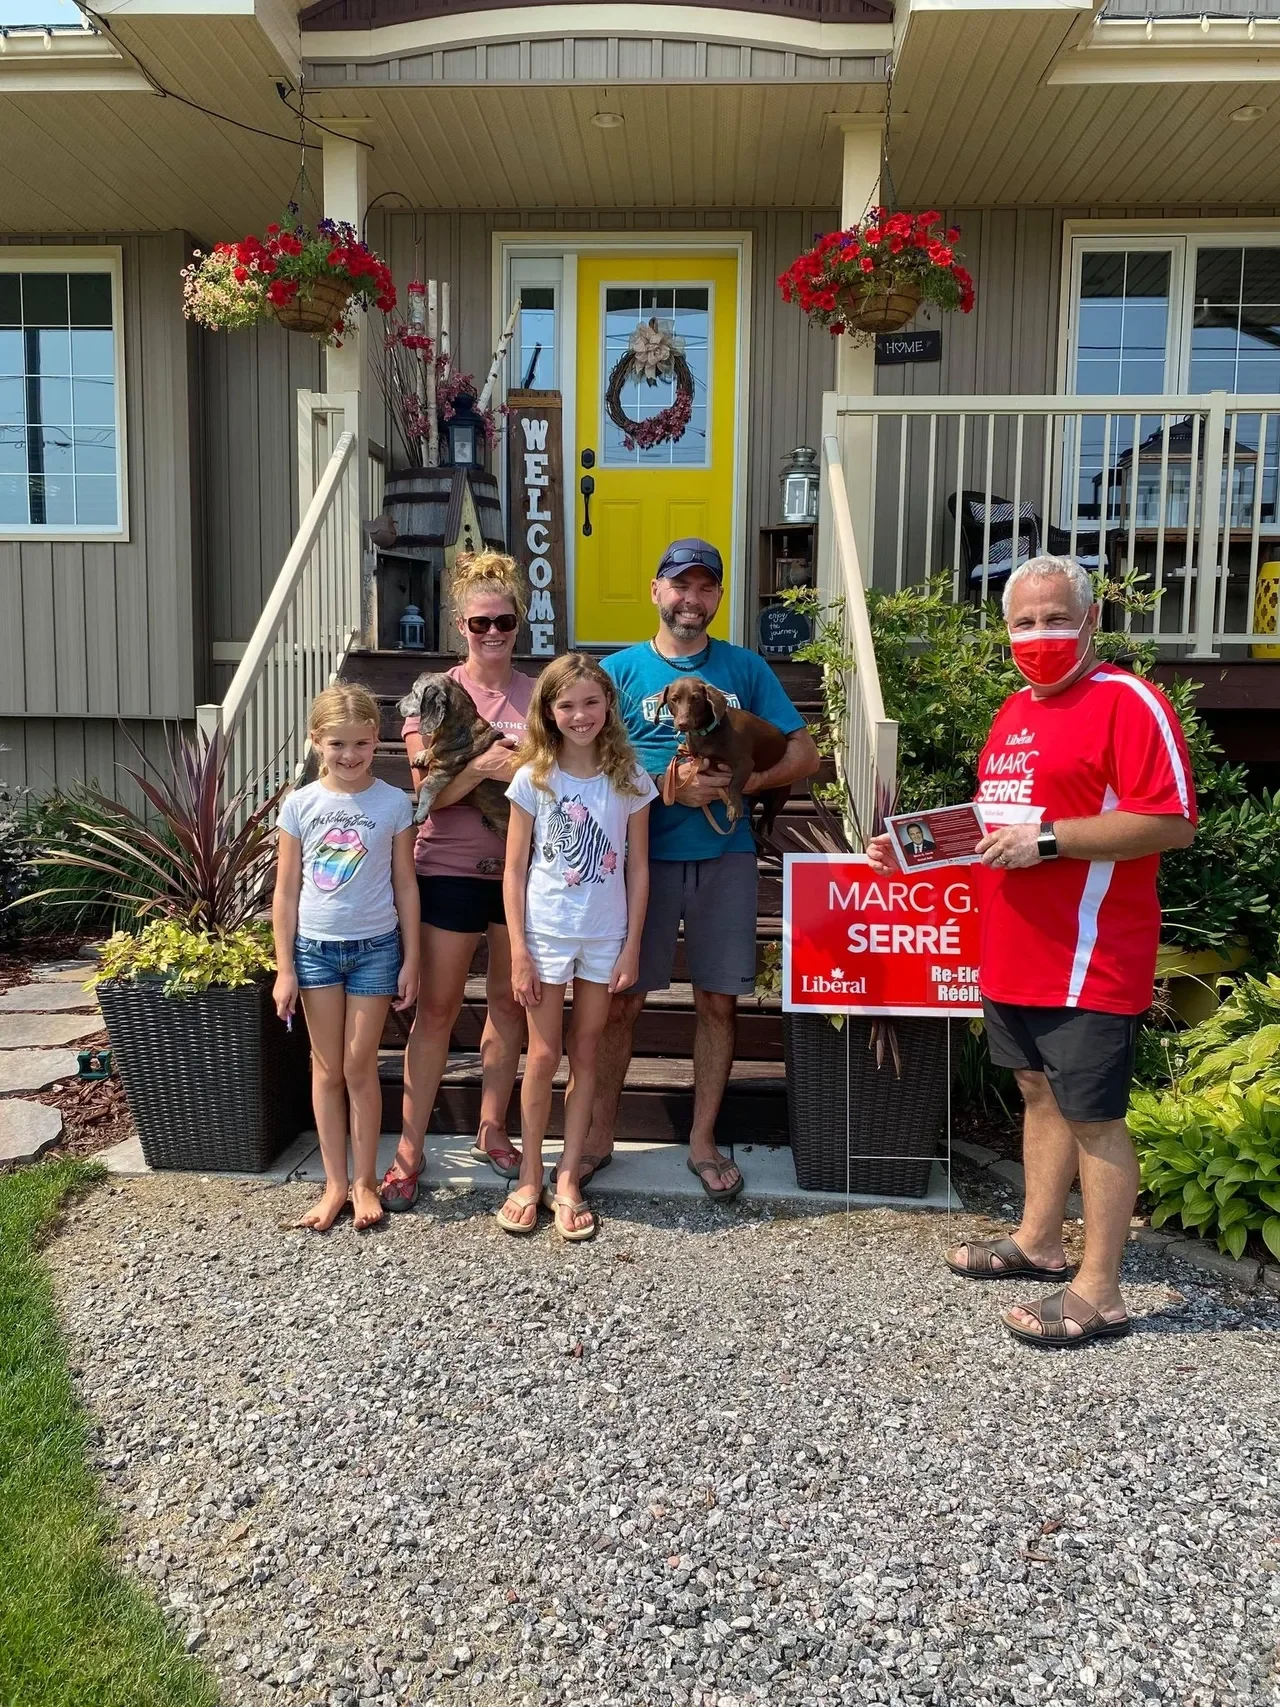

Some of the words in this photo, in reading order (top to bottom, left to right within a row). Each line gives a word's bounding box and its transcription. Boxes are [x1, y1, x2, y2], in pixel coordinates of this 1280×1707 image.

[521, 418, 555, 655] WELCOME
[768, 611, 788, 623] enjoy
[769, 629, 799, 641] journey
[985, 751, 1040, 775] MARC
[977, 774, 1035, 804] SERRÉ
[828, 881, 935, 913] MARC
[943, 883, 980, 914] G.
[846, 918, 962, 955] SERRÉ
